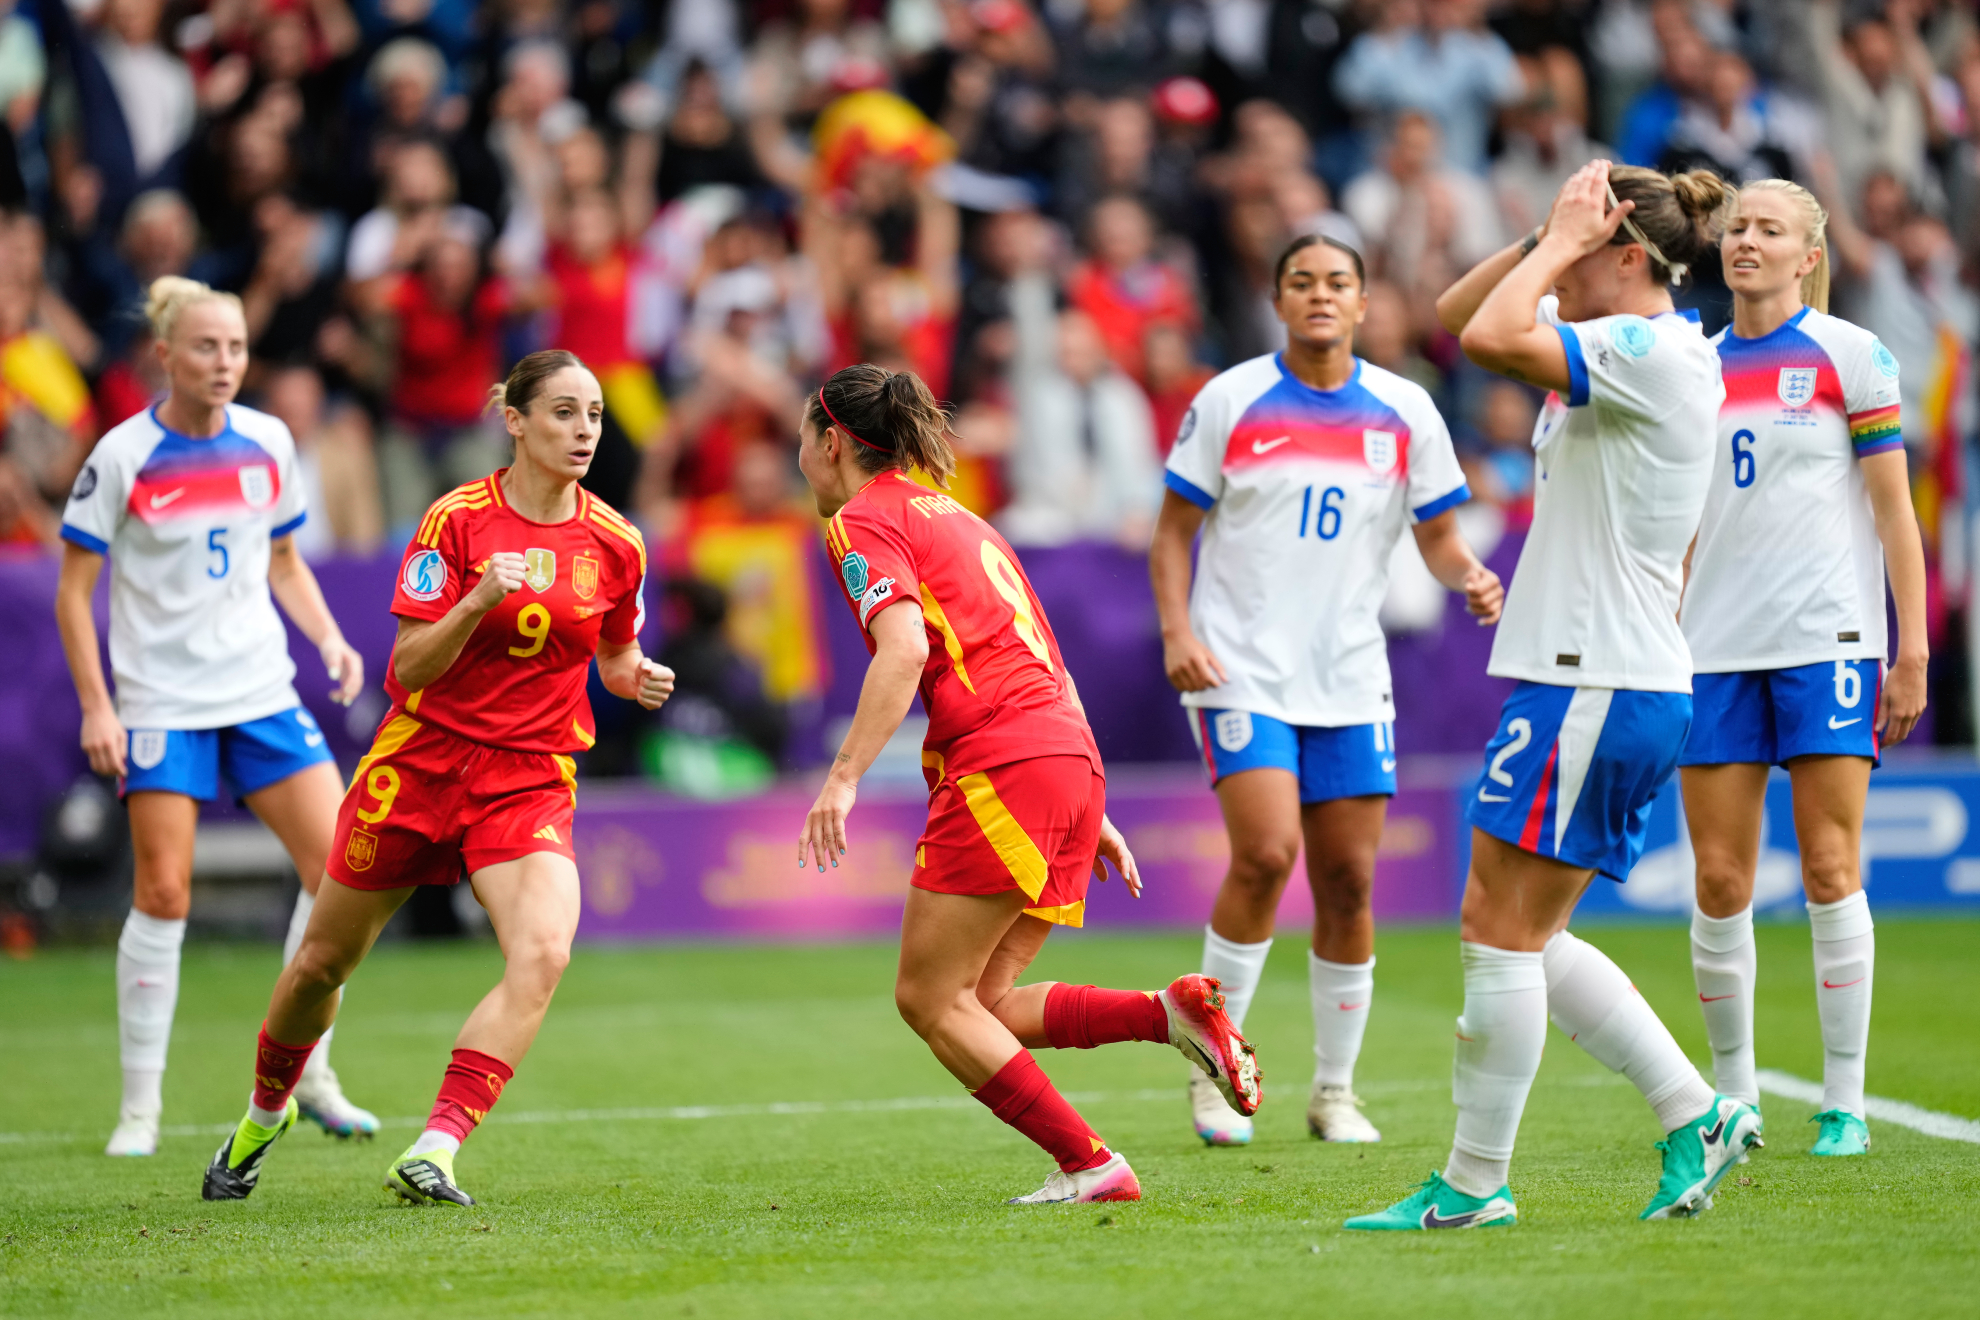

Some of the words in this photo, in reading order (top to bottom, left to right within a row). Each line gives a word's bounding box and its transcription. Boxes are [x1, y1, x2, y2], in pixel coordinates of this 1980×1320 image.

[1731, 428, 1756, 489] 6
[1299, 485, 1345, 541] 16
[208, 528, 229, 580] 5
[508, 602, 551, 658] 9
[1832, 659, 1862, 710] 6
[1488, 716, 1532, 788] 2
[356, 764, 401, 824] 9
